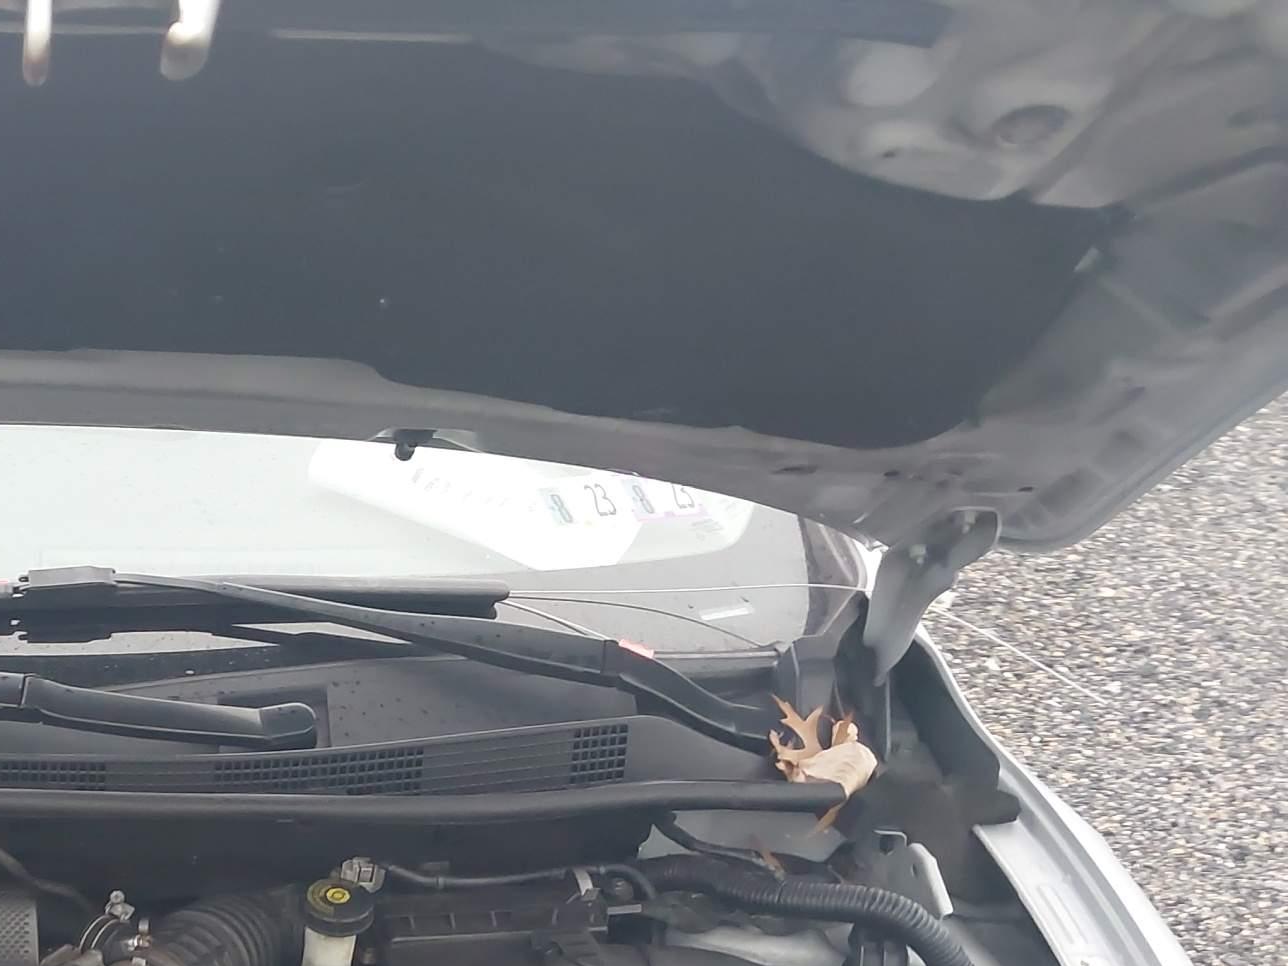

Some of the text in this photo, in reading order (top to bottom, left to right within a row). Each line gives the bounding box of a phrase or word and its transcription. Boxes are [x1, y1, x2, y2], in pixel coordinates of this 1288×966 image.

[550, 482, 617, 524] 8 23
[631, 484, 655, 514] 8
